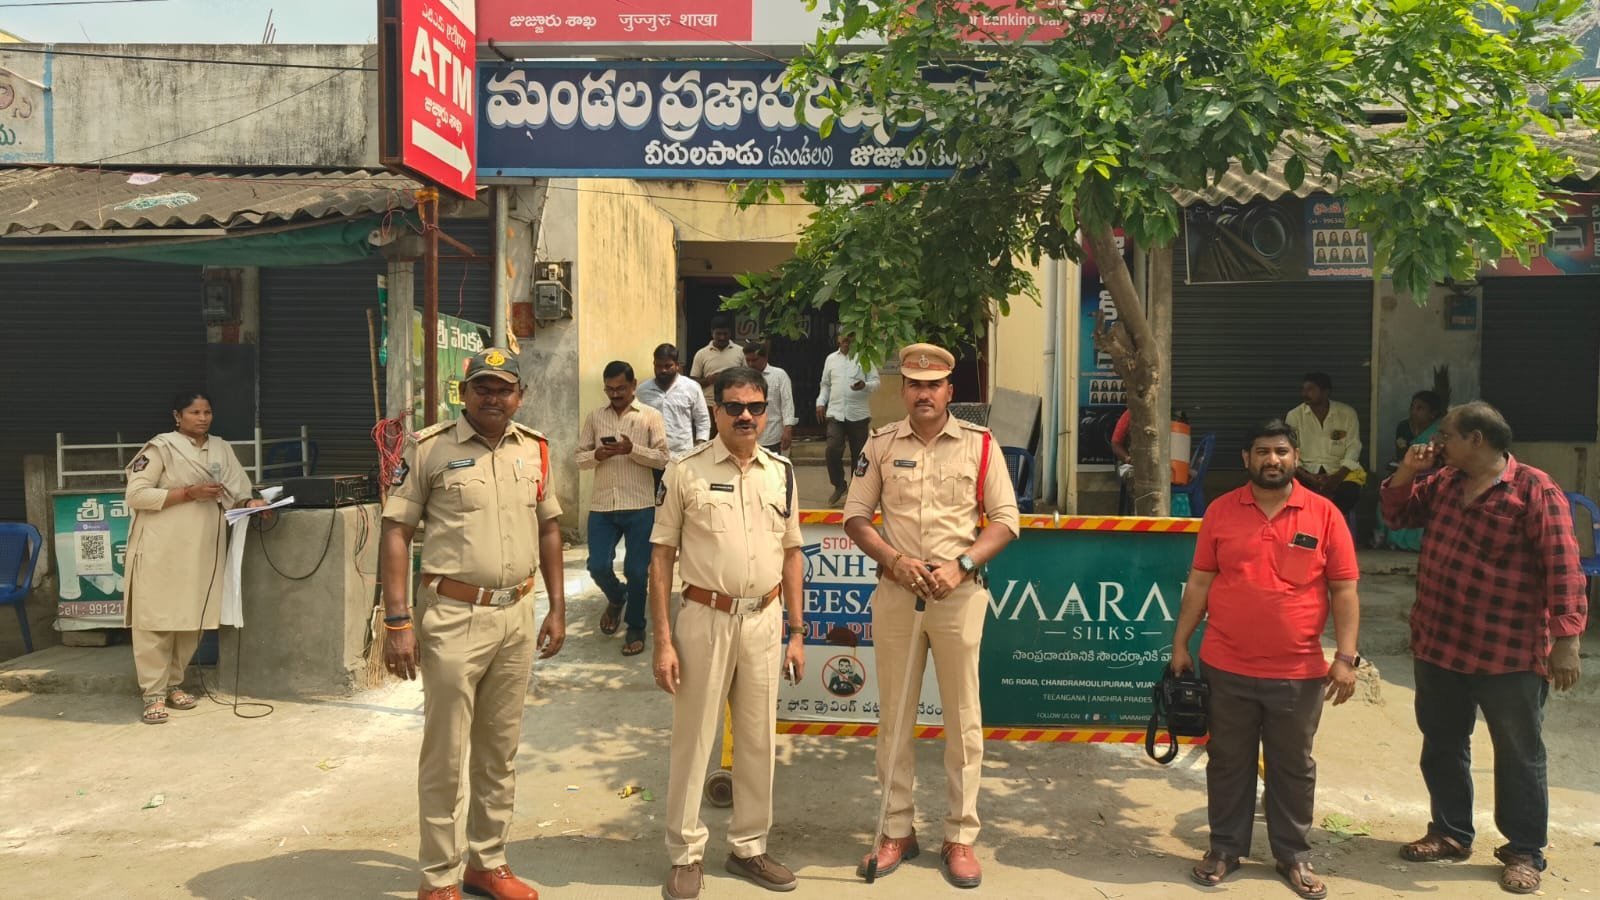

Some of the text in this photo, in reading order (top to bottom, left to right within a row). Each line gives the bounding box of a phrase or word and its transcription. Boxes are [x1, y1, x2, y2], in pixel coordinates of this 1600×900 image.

[509, 14, 597, 34] జుజ్జూరు శాఖ
[679, 14, 718, 27] शाखा
[410, 26, 472, 117] ATM
[486, 69, 652, 128] మండల
[644, 138, 764, 166] వీరులపాడు
[76, 498, 105, 522] శ్రీ
[817, 554, 878, 577] NH-
[88, 603, 122, 615] 99121
[1072, 626, 1136, 641] SILKS
[1001, 678, 1014, 686] MG
[1016, 678, 1040, 687] ROAD,
[1043, 694, 1086, 702] TELANGANA
[1091, 695, 1122, 703] ANDHRA
